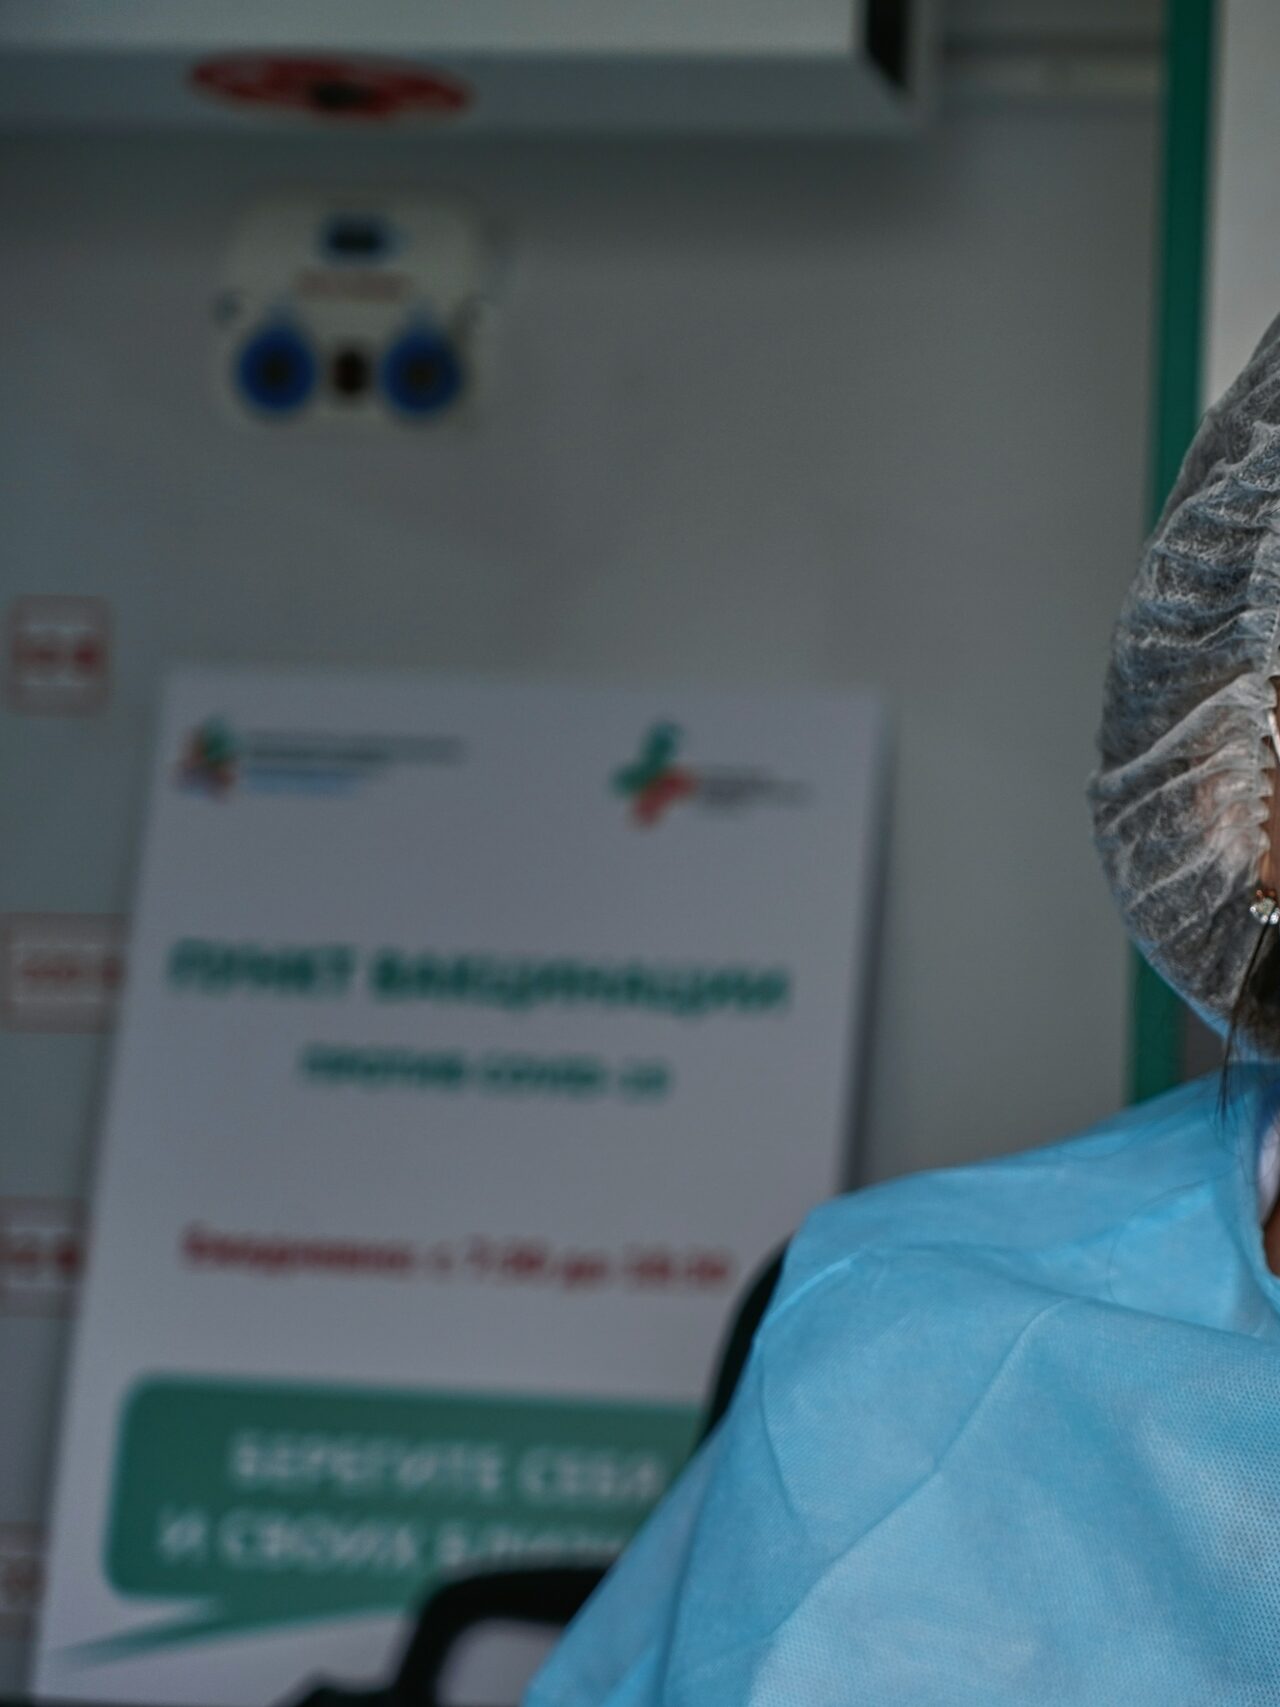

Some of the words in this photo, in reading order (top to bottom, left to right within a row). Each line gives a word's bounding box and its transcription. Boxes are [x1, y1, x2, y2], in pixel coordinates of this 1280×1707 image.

[167, 940, 356, 997] ПУНКТ
[371, 948, 792, 1017] ВАКЦИНАЦИИ
[300, 1043, 467, 1093] ПРОТИВ
[231, 1429, 505, 1494] БЕРЕГИТЕ
[522, 1445, 664, 1505] СЕБЯ
[158, 1504, 208, 1566] И
[221, 1509, 417, 1571] СВОИХ
